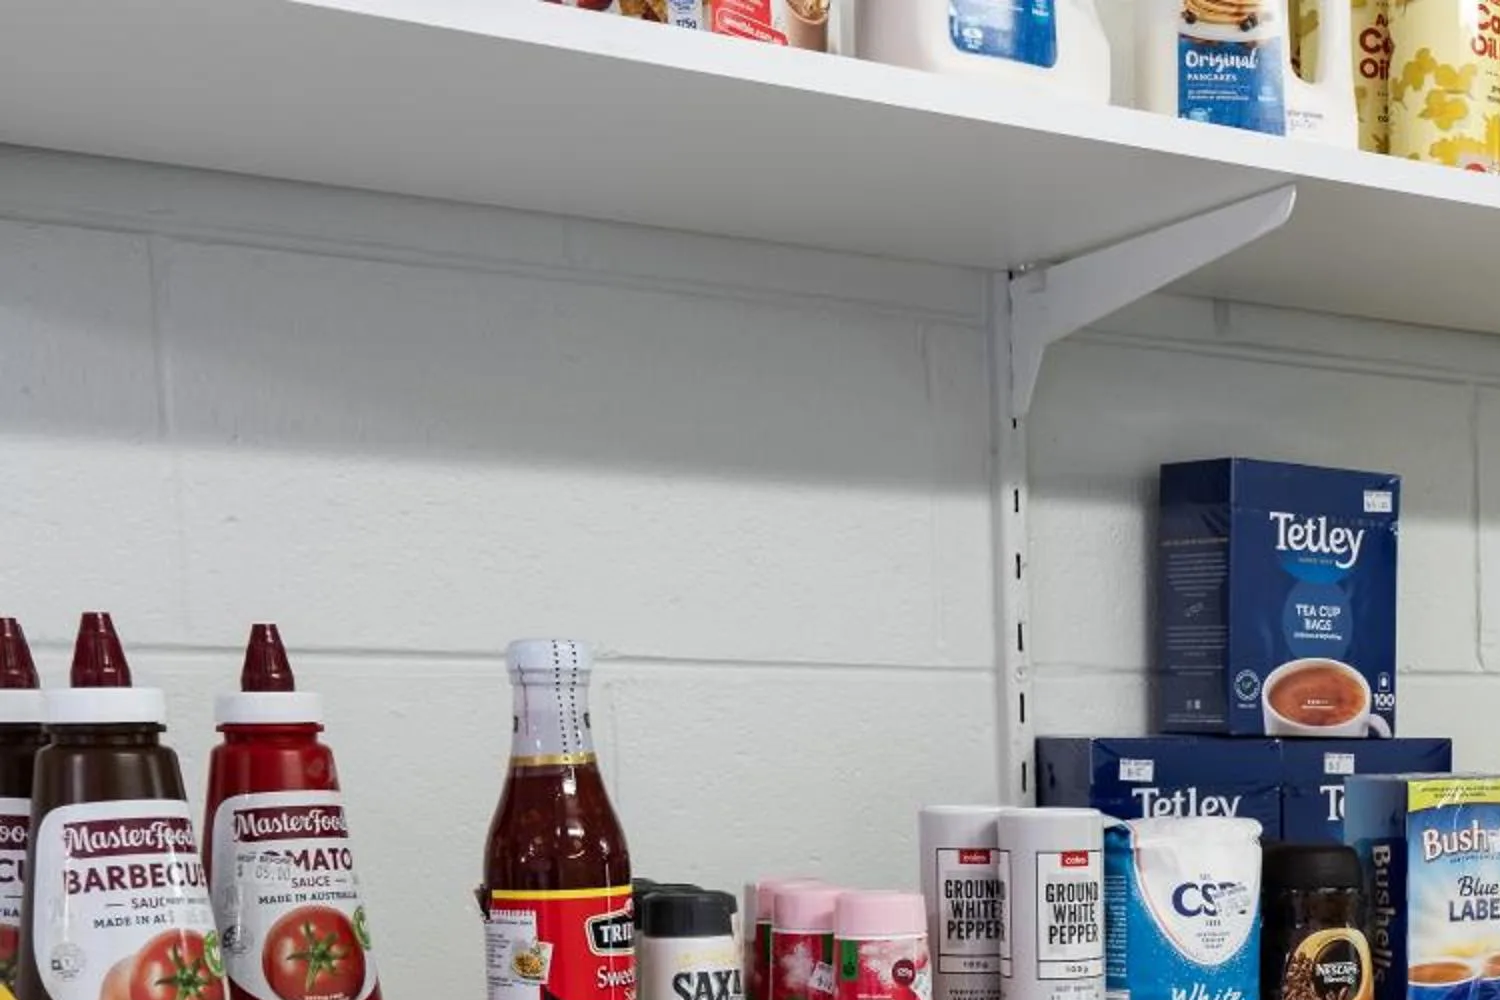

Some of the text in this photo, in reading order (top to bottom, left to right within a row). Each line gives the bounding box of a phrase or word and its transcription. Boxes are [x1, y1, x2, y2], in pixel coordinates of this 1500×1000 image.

[1186, 47, 1259, 71] Original
[1269, 511, 1364, 569] Tetley
[1295, 604, 1340, 617] TEA CUP
[1304, 618, 1332, 631] BAGS
[1373, 693, 1395, 706] 100
[292, 876, 331, 888] SAUCE
[1457, 875, 1499, 897] Blue
[258, 895, 292, 904] MADE
[296, 894, 306, 902] IN
[1046, 882, 1099, 902] GROUND
[131, 897, 167, 909] SAUC
[1053, 903, 1095, 923] WHITE
[1371, 845, 1397, 981] Bushells
[93, 919, 131, 928] MADE
[1048, 923, 1098, 944] PEPPER
